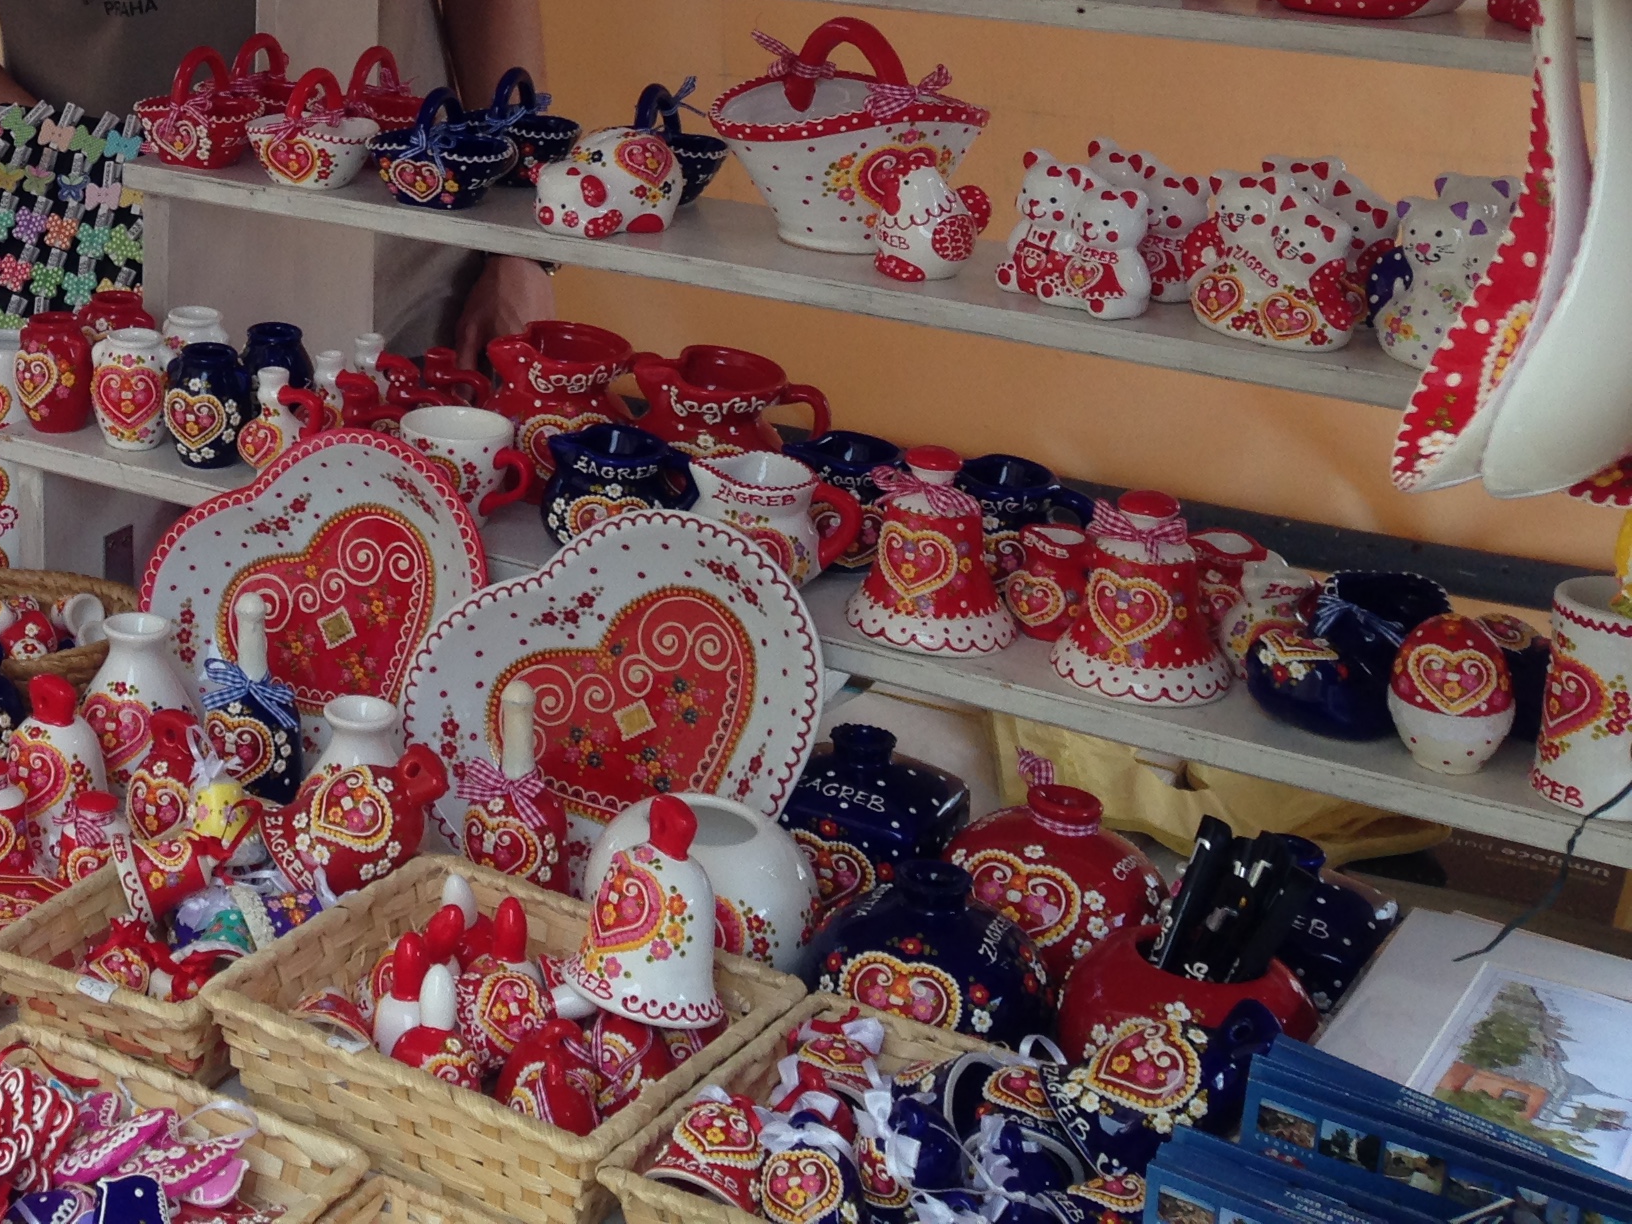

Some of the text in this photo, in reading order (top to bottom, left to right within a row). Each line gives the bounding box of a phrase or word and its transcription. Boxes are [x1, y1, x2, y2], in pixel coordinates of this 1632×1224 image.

[877, 228, 910, 251] GREB
[1233, 243, 1279, 288] ZAGREB
[572, 454, 658, 481] ZAGREB
[711, 482, 797, 507] ZAGREB
[1530, 762, 1585, 809] GREB
[264, 814, 316, 895] ZAGREB
[566, 960, 614, 1001] GREB
[1041, 1063, 1091, 1142] ZAGREB
[661, 1154, 741, 1197] ZAGREB
[1282, 1189, 1323, 1209] ZAGREB
[1294, 1202, 1335, 1223] ZAGREB
